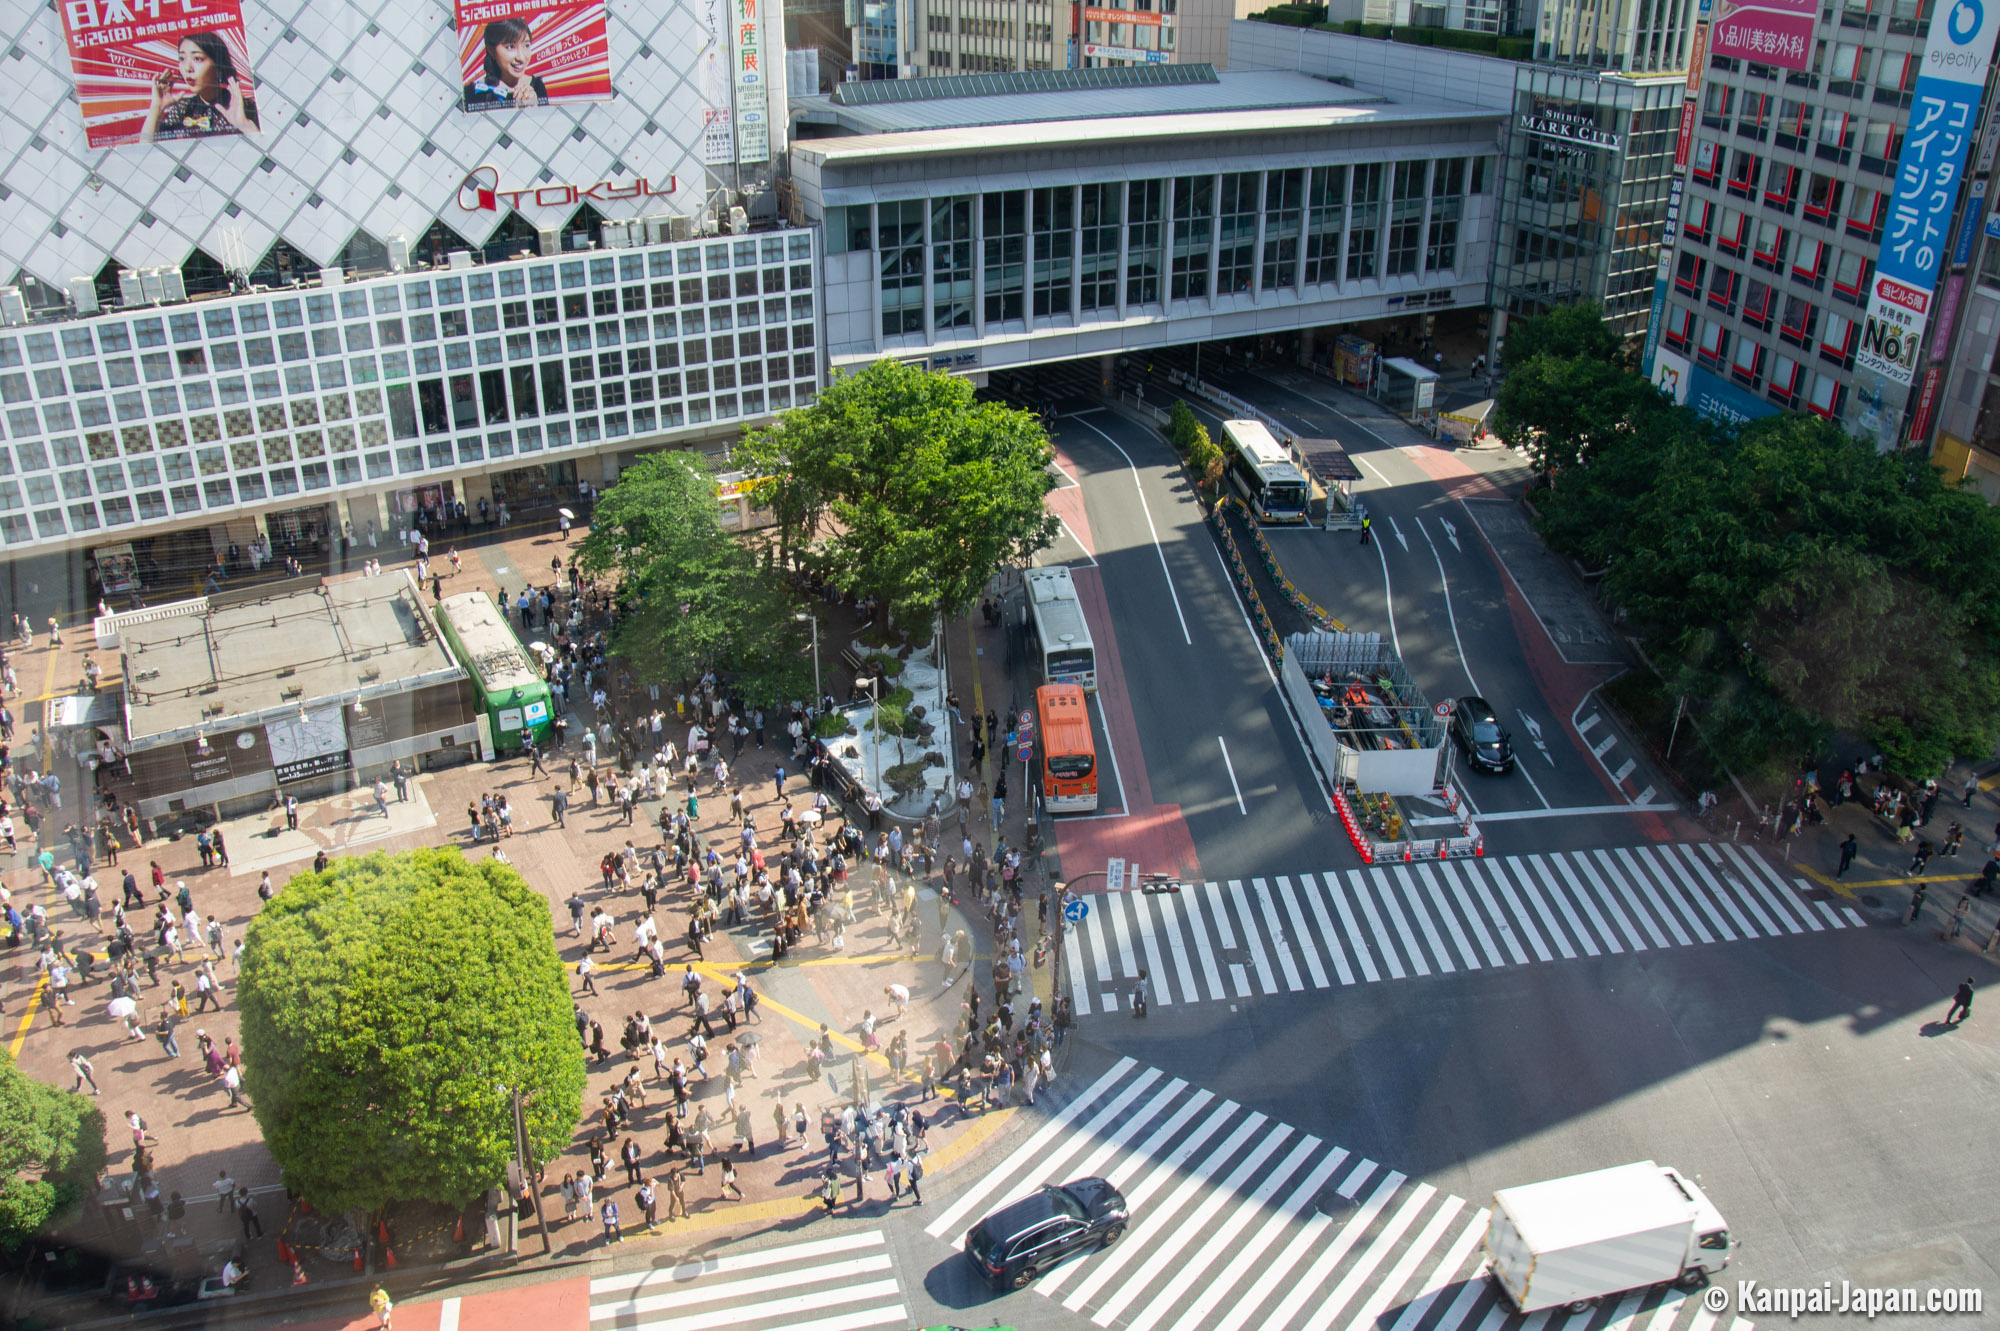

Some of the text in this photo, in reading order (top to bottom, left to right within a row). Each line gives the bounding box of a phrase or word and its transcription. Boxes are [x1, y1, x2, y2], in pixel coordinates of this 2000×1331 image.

[136, 19, 188, 37] 東京競馬場
[738, 0, 758, 71] 物産展
[1724, 25, 1805, 60] 品川美容外科
[1931, 50, 1981, 74] eyecity
[1521, 114, 1622, 146] MARK CITY
[1545, 109, 1594, 126] SHIBUYA
[496, 173, 676, 210] TOKYU
[1892, 96, 1946, 264] アイシティ
[1915, 102, 1969, 271] コンタクトの
[1881, 283, 1925, 310] 当ビル5階
[1879, 304, 1912, 326] 利用者数
[1861, 315, 1920, 370] No.1
[1858, 352, 1911, 382] コンタクトショップ
